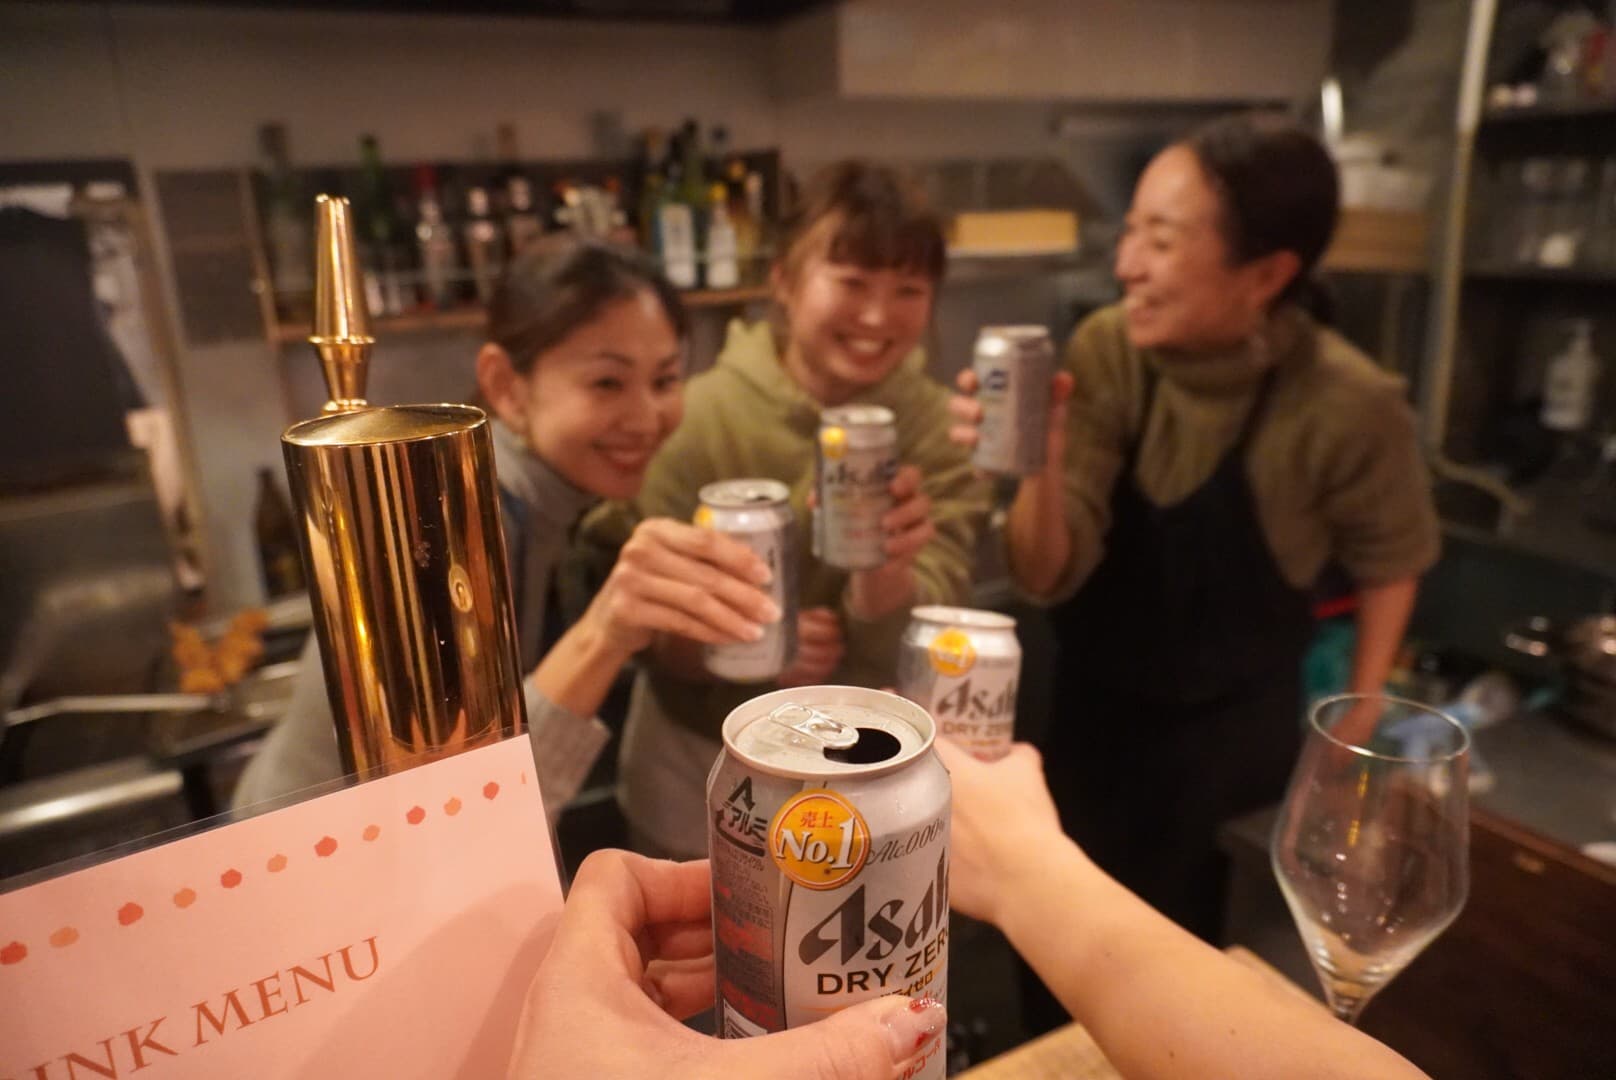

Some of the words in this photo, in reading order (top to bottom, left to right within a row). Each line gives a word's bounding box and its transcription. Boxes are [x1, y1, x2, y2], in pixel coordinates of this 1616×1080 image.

[727, 803, 768, 843] アルミ
[775, 816, 857, 870] No.1
[799, 810, 834, 829] 売上
[817, 963, 894, 995] DRY
[904, 921, 948, 979] ZER
[190, 936, 380, 1047] MENU
